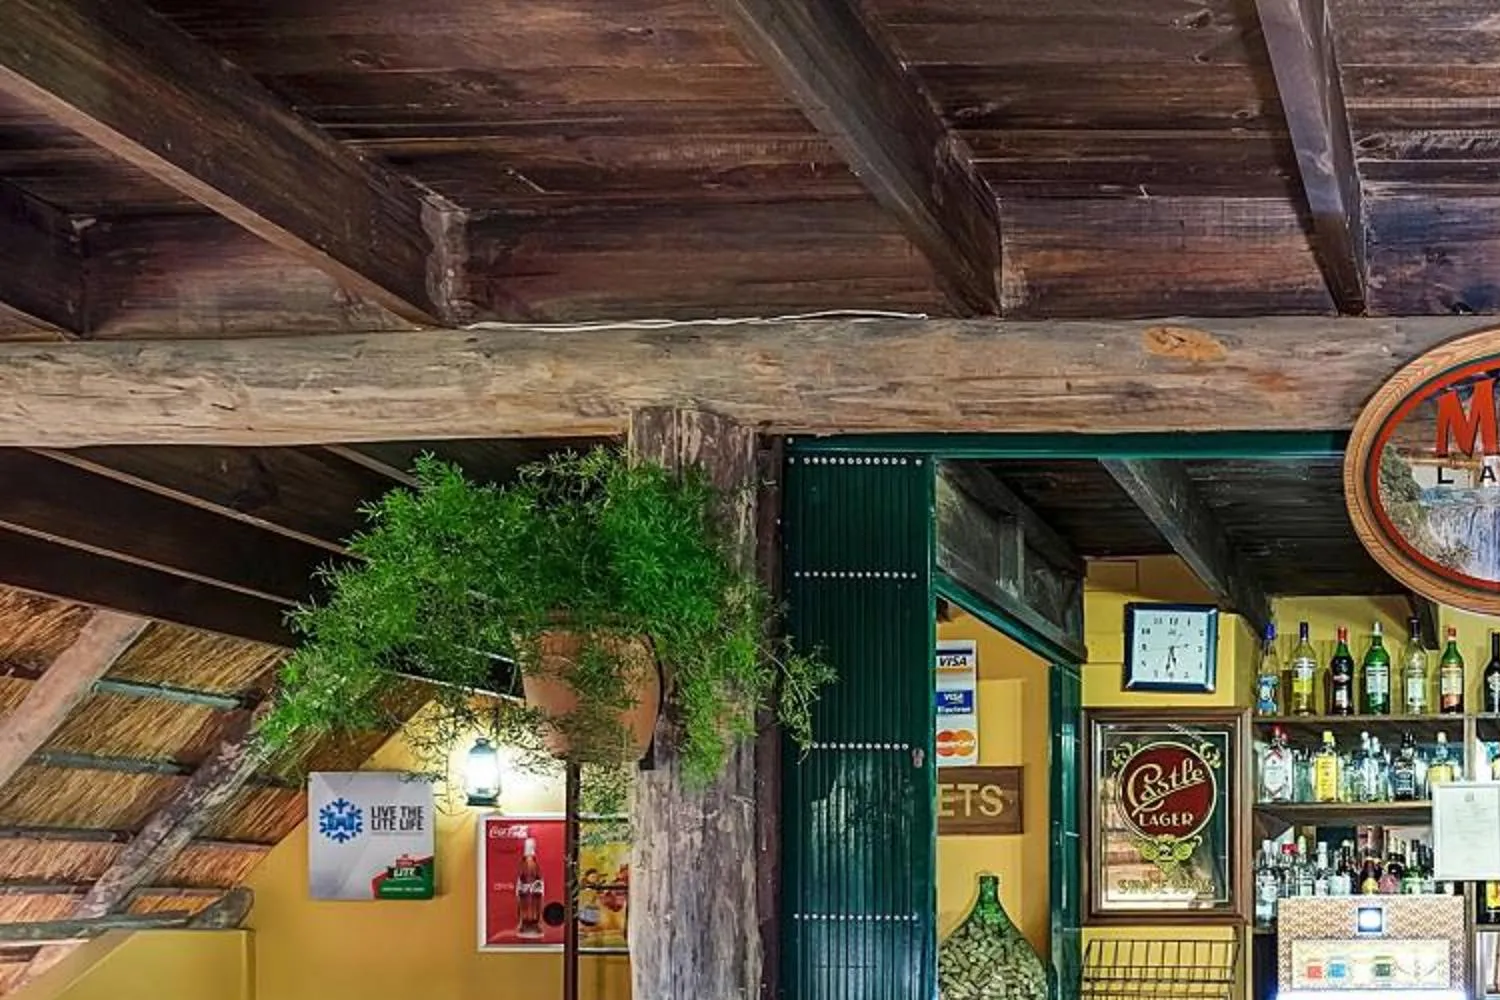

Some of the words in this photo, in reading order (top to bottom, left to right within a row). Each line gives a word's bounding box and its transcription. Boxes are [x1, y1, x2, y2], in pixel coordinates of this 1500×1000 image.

[940, 656, 967, 667] VISA
[1127, 757, 1206, 817] Castle
[937, 783, 1003, 817] ETS
[370, 805, 397, 819] LIVE
[400, 805, 424, 819] THE
[370, 818, 397, 831] LITE
[400, 818, 424, 831] LIFE
[1140, 812, 1194, 827] LAGER
